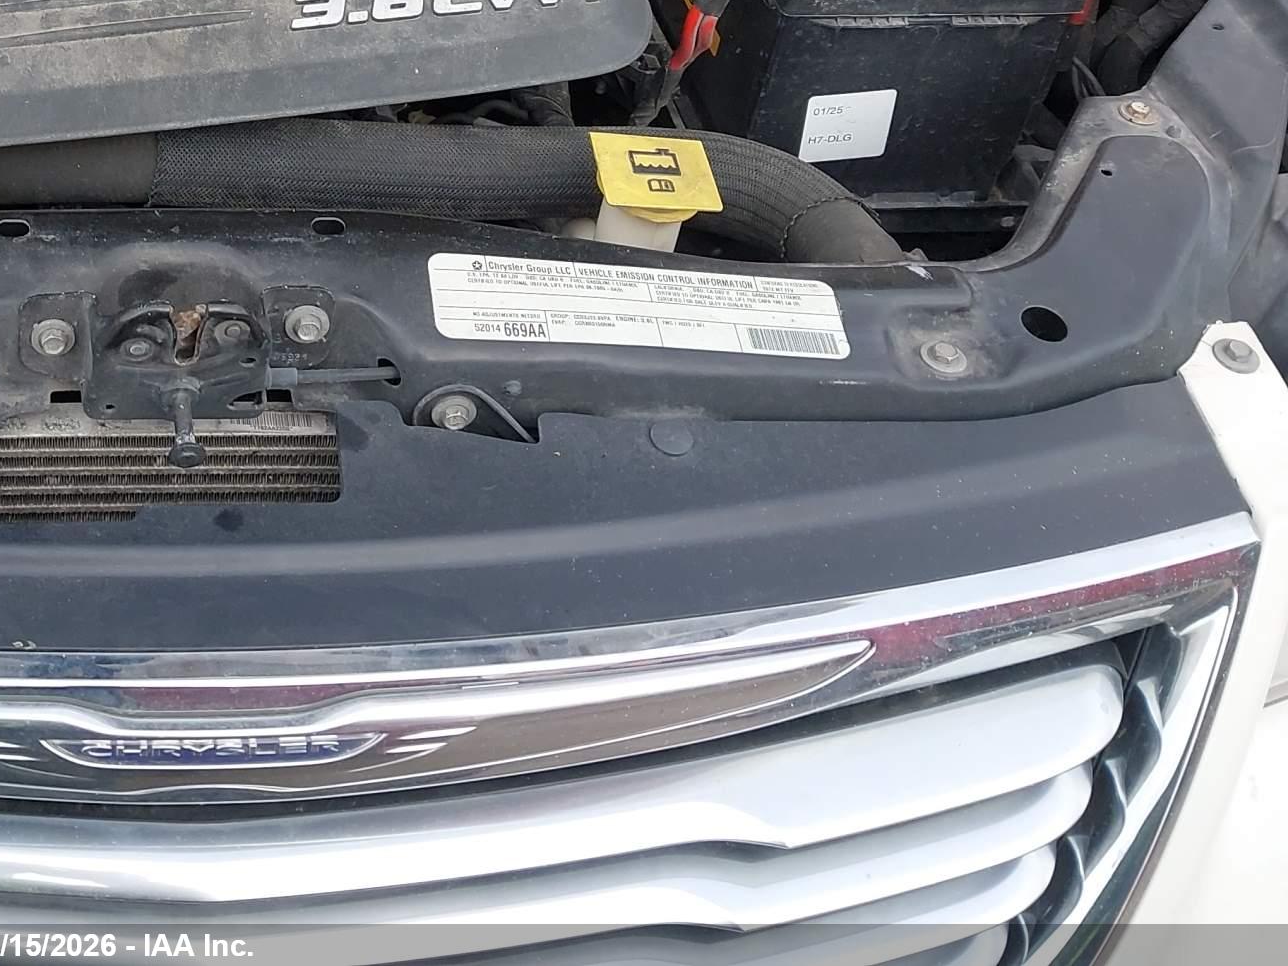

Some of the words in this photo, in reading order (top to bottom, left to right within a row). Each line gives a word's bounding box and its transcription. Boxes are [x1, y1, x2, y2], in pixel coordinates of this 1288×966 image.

[813, 106, 844, 116] 01/25
[808, 134, 852, 145] H7-DLG
[488, 261, 523, 271] Chrysler
[526, 264, 552, 274] Group
[555, 266, 571, 275] LLC
[578, 268, 613, 278] VEHICLE
[615, 270, 655, 281] EMISSION
[657, 274, 696, 284] CONTROL
[697, 277, 753, 289] INFORMATION
[474, 323, 501, 332] 52014
[504, 322, 547, 338] 669AA
[81, 734, 340, 758] CHRYSLER
